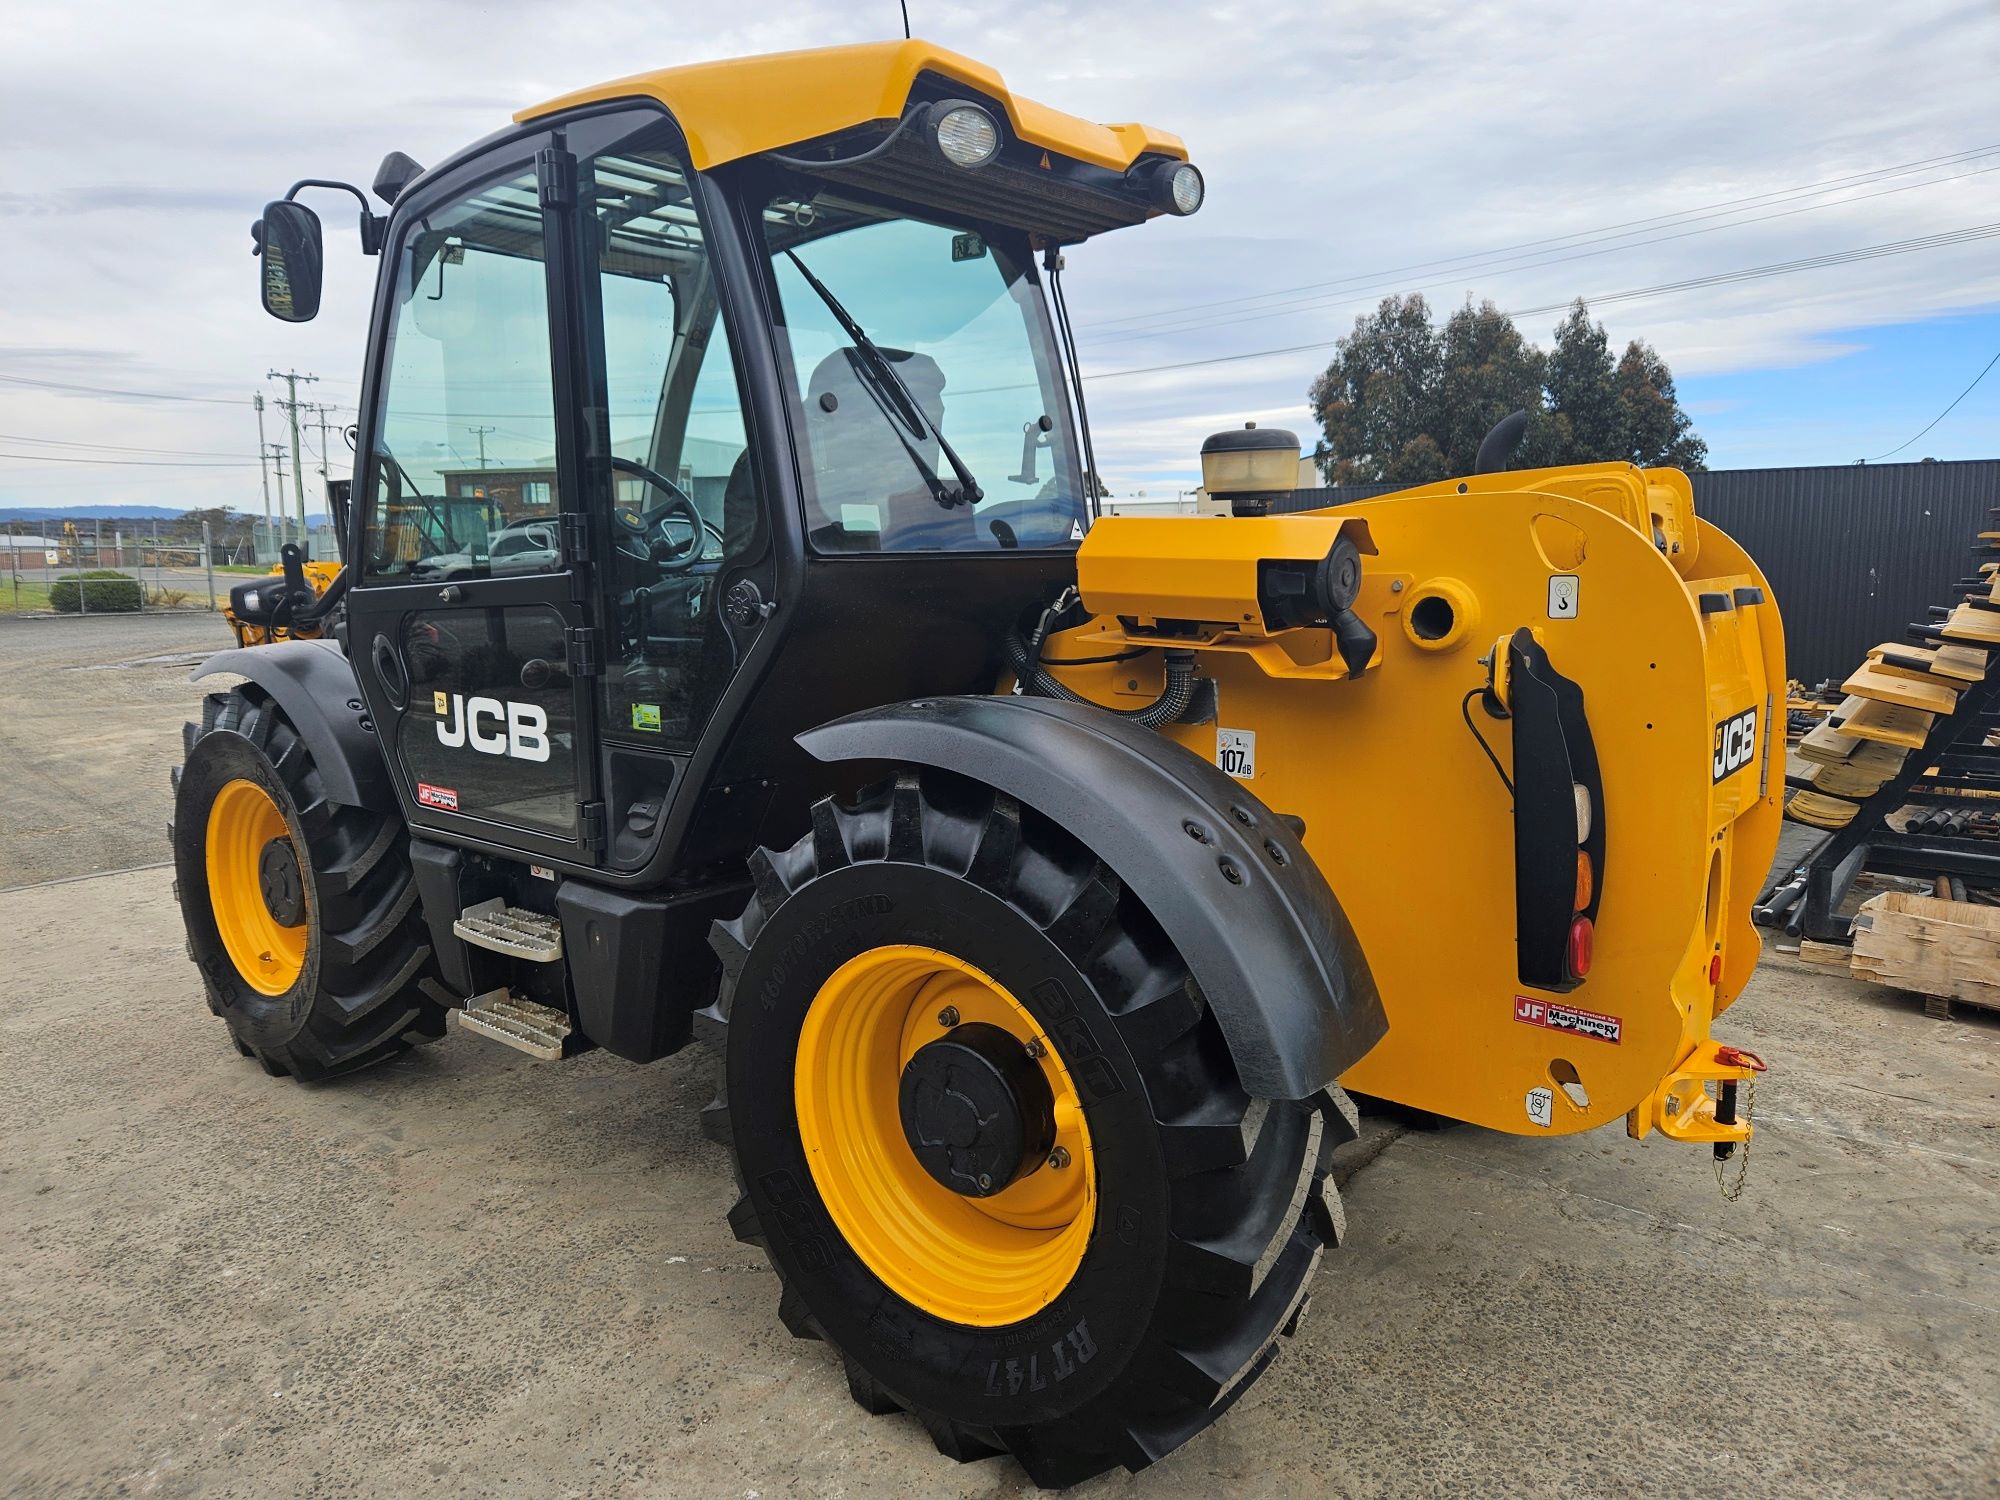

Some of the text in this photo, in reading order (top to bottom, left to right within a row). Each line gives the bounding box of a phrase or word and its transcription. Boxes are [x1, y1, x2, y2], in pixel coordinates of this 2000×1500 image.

[434, 691, 550, 762] JCB
[1713, 711, 1756, 779] JCB
[1220, 750, 1245, 774] 107
[420, 788, 430, 800] JF
[1518, 1003, 1618, 1033] JF Machinery
[1579, 1010, 1606, 1020] Serviced
[1031, 977, 1127, 1101] BKT
